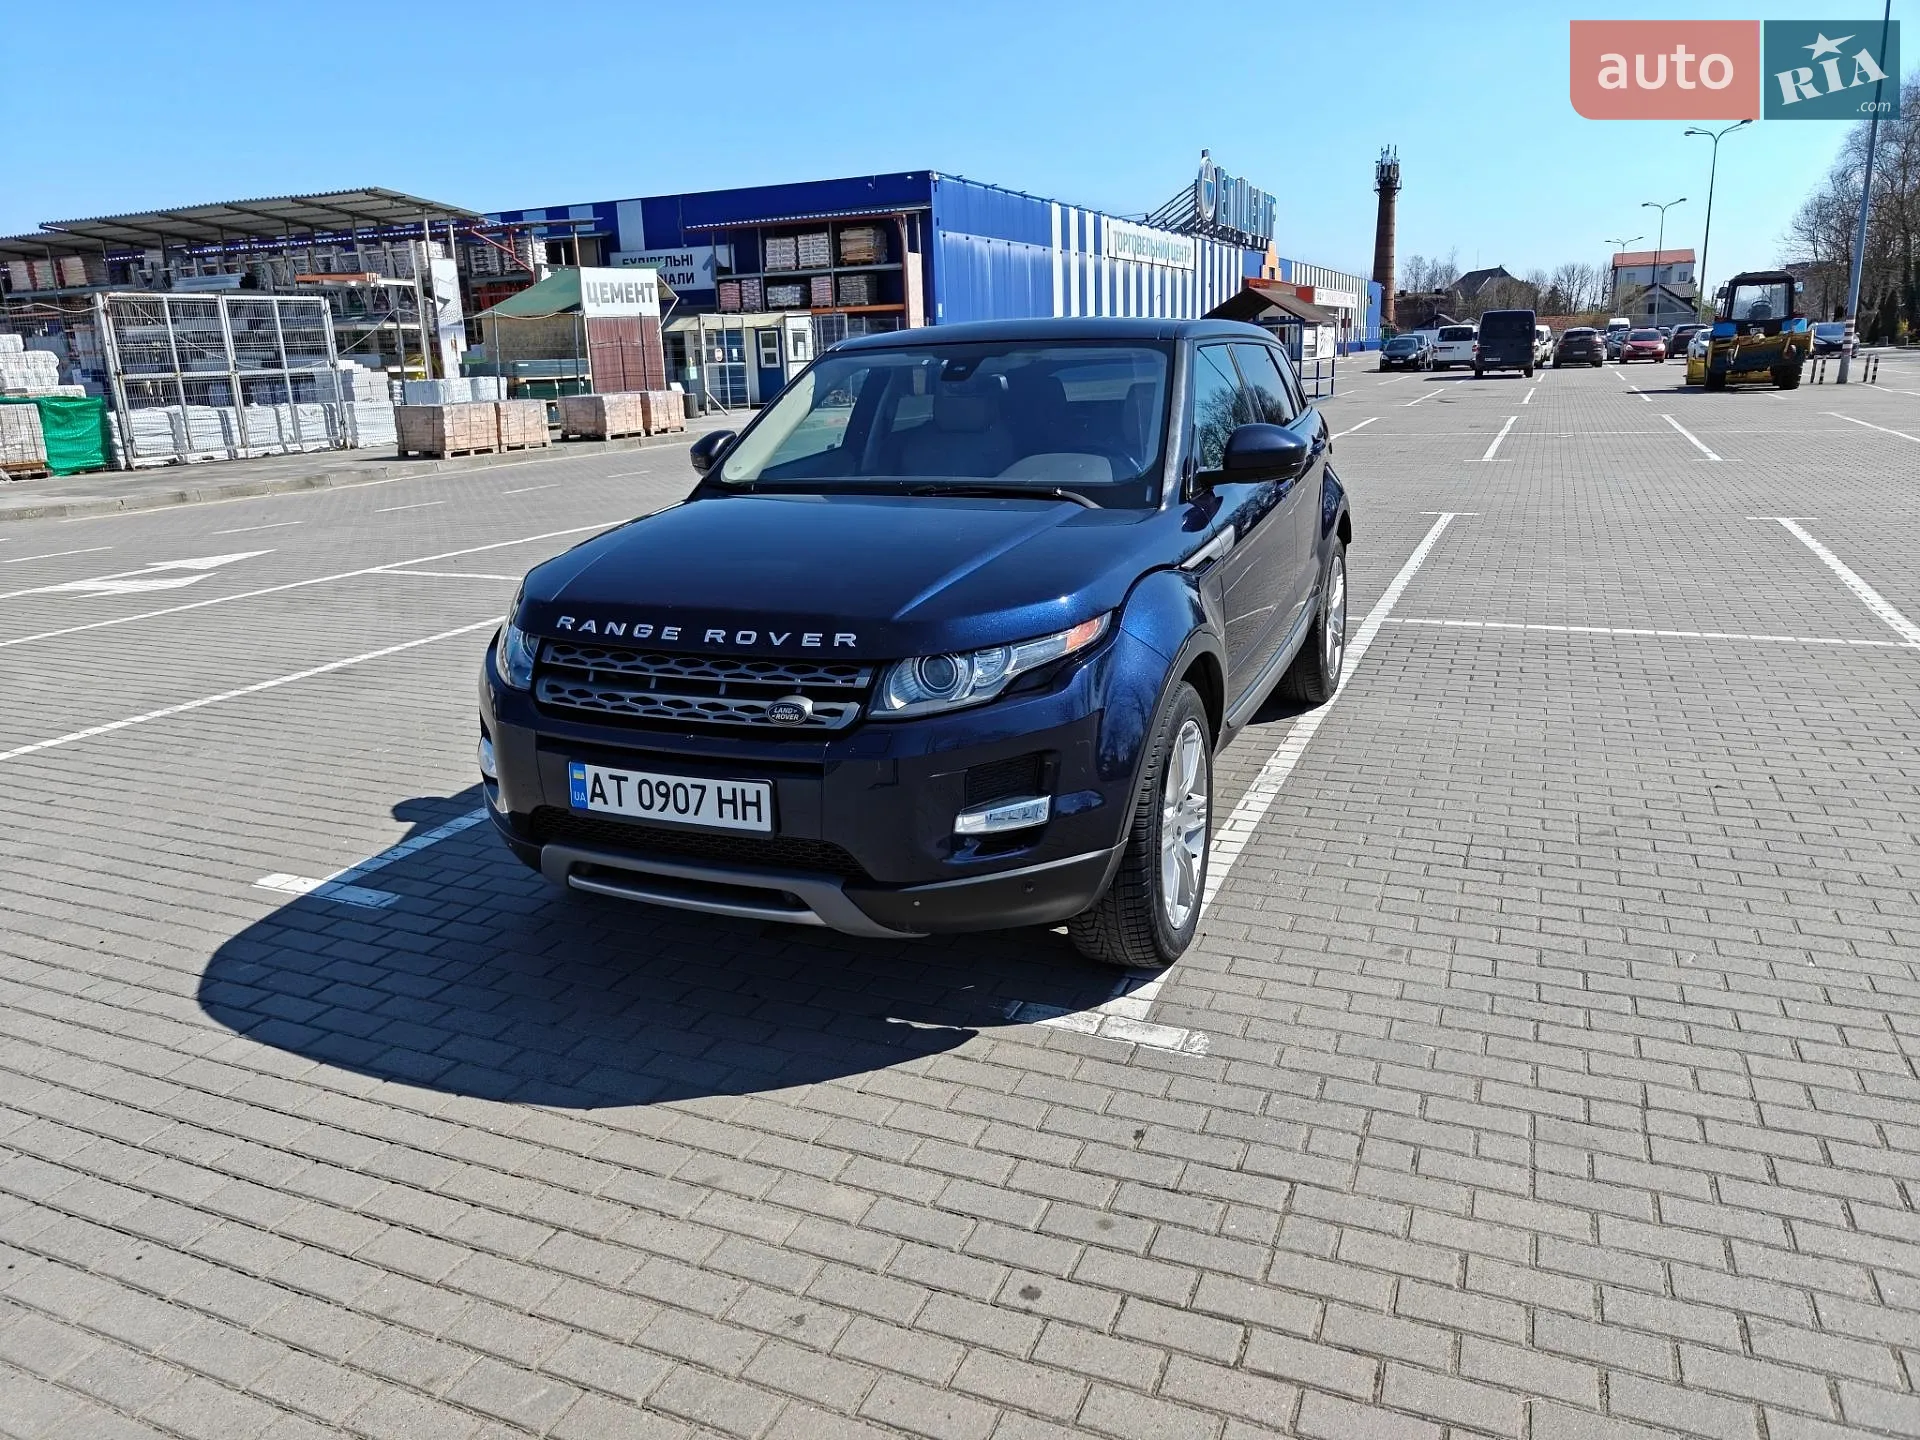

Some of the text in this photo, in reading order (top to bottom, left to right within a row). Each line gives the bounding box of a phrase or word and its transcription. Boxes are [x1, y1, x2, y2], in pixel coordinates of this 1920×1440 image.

[585, 281, 655, 307] ЦЕМЕНТ
[556, 615, 857, 648] RANGE ROVER
[574, 791, 587, 802] UA
[589, 773, 763, 823] AT 0907 HH
